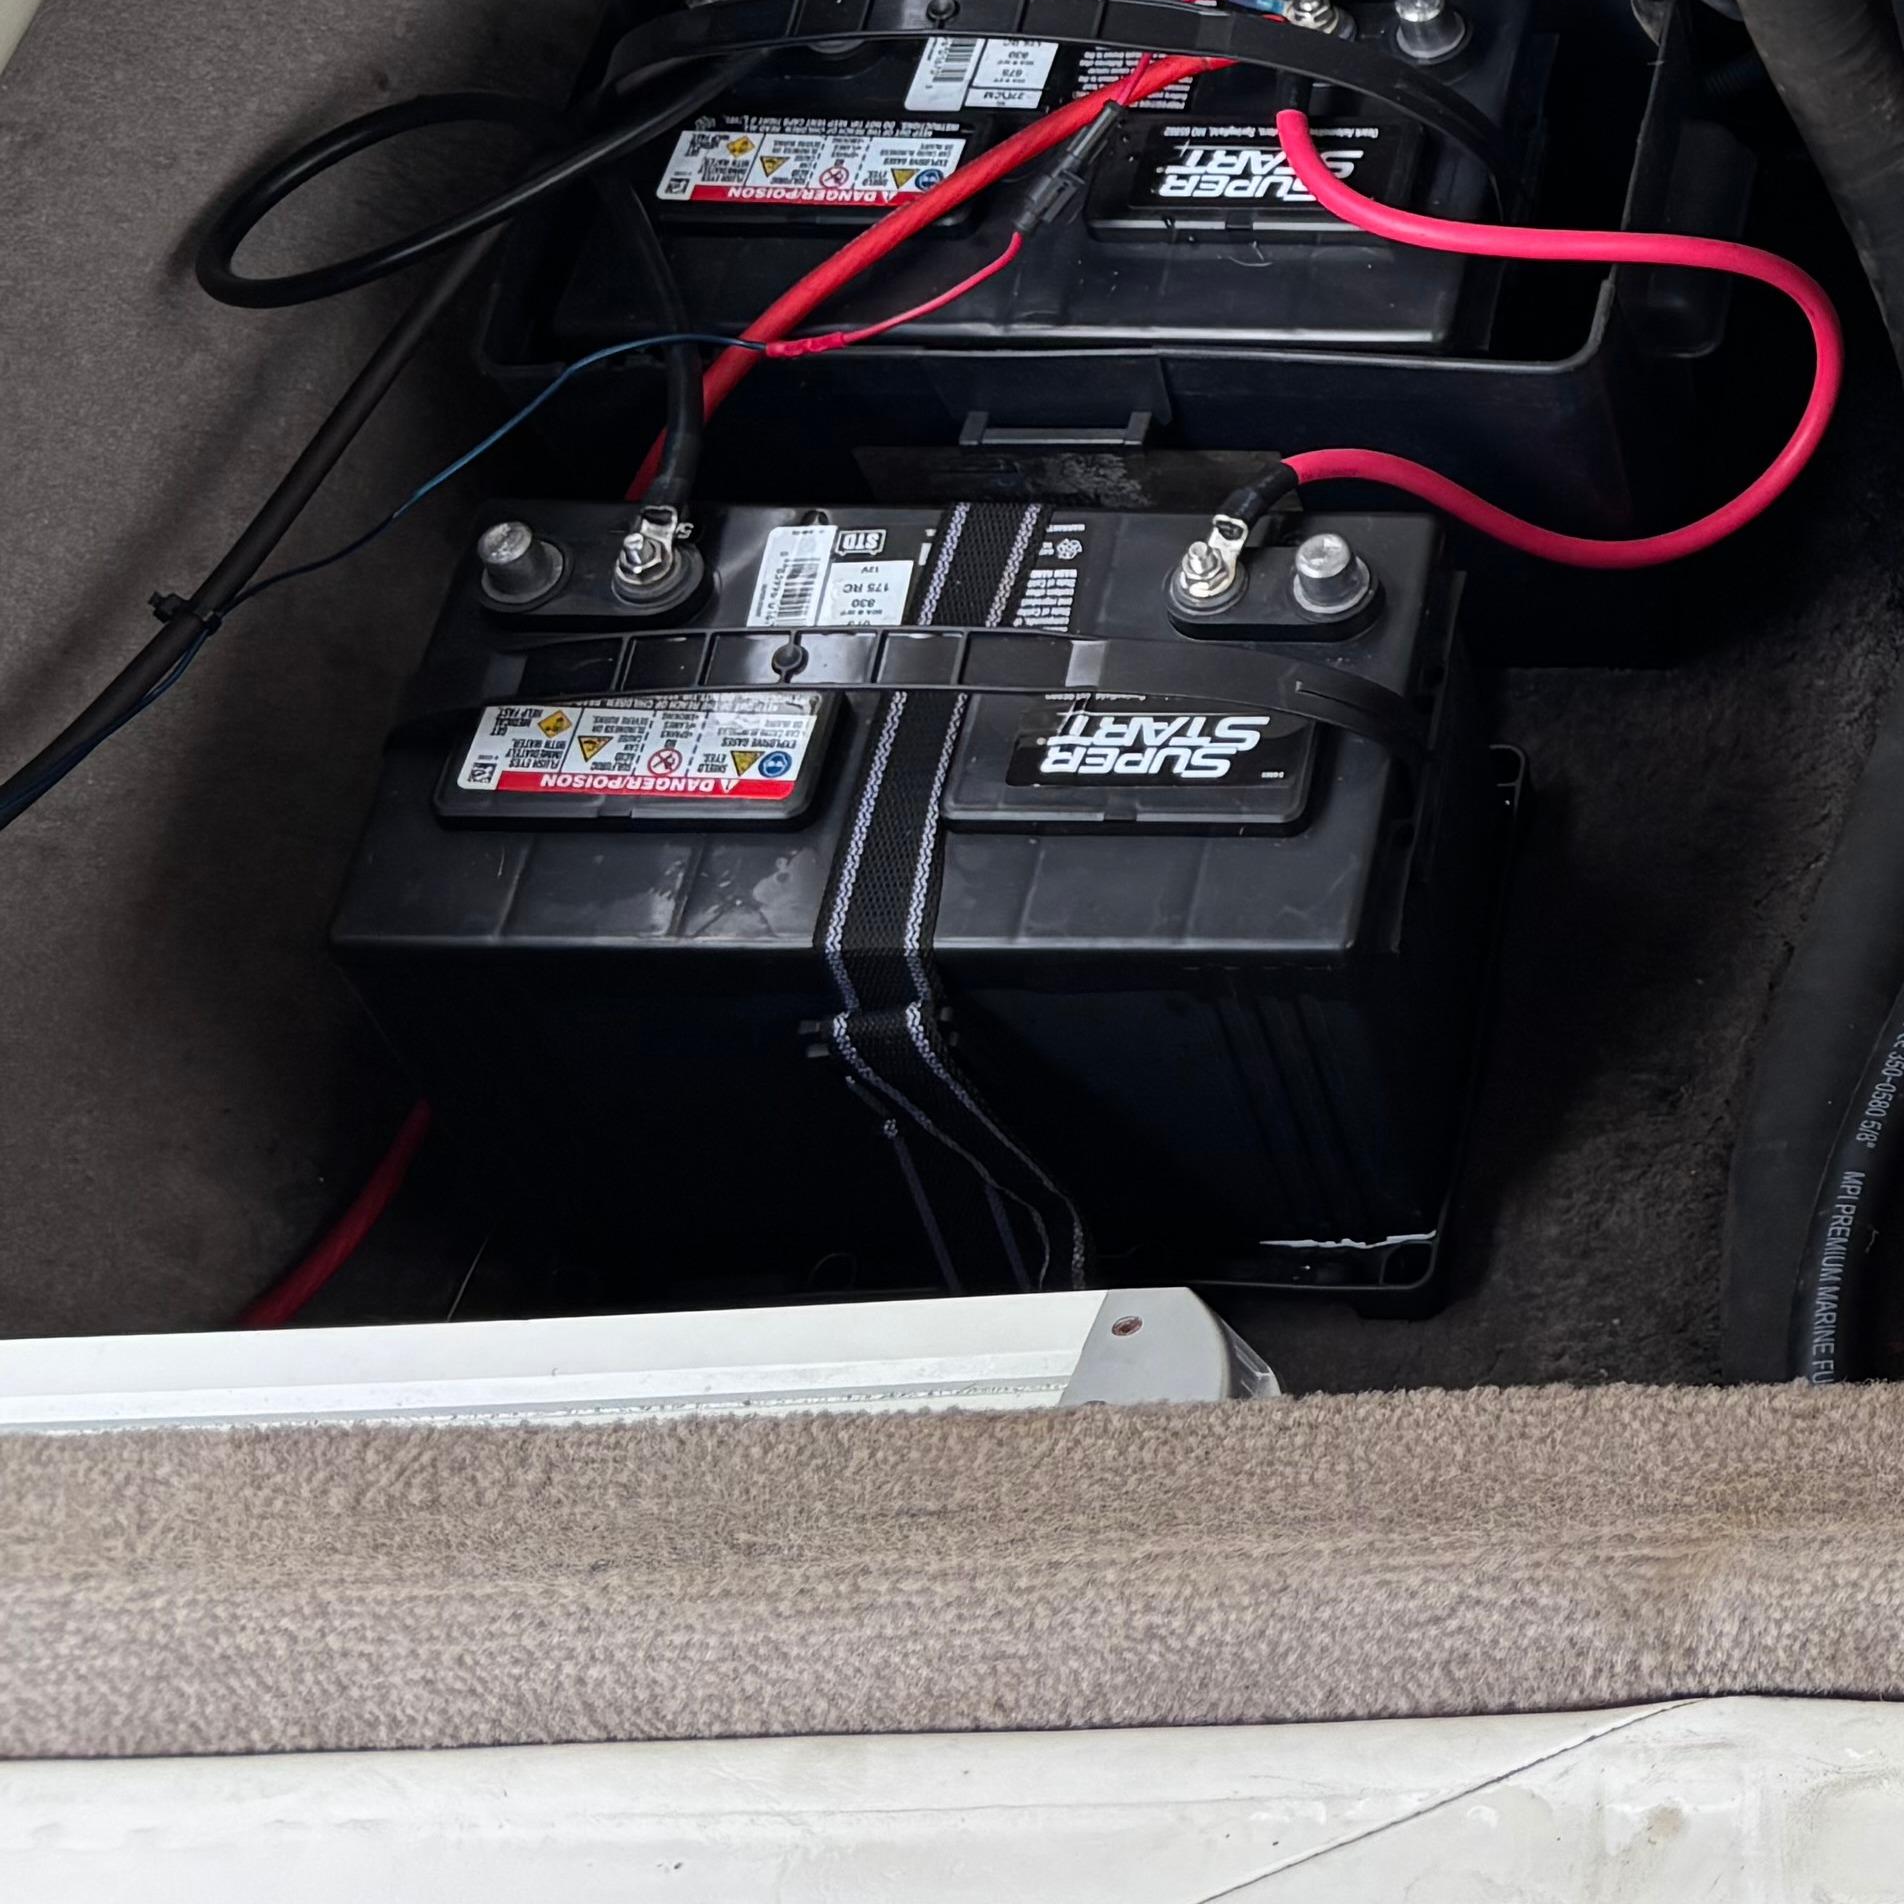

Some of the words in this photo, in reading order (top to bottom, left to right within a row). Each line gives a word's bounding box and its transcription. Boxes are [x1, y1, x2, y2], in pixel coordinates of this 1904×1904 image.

[1164, 149, 1364, 178] SART
[727, 187, 877, 203] DANGER/POISON
[1159, 174, 1317, 201] SUPER
[844, 533, 879, 550] STD
[867, 583, 890, 593] 175
[852, 598, 876, 609] 830
[1047, 715, 1270, 752] START
[1040, 747, 1237, 778] SUPER
[539, 773, 715, 792] DANGER/POISON
[1856, 1120, 1883, 1148] 5/8"
[1837, 1171, 1866, 1200] MPI
[1818, 1204, 1857, 1281] PREMIUM
[1812, 1285, 1841, 1356] MARINE
